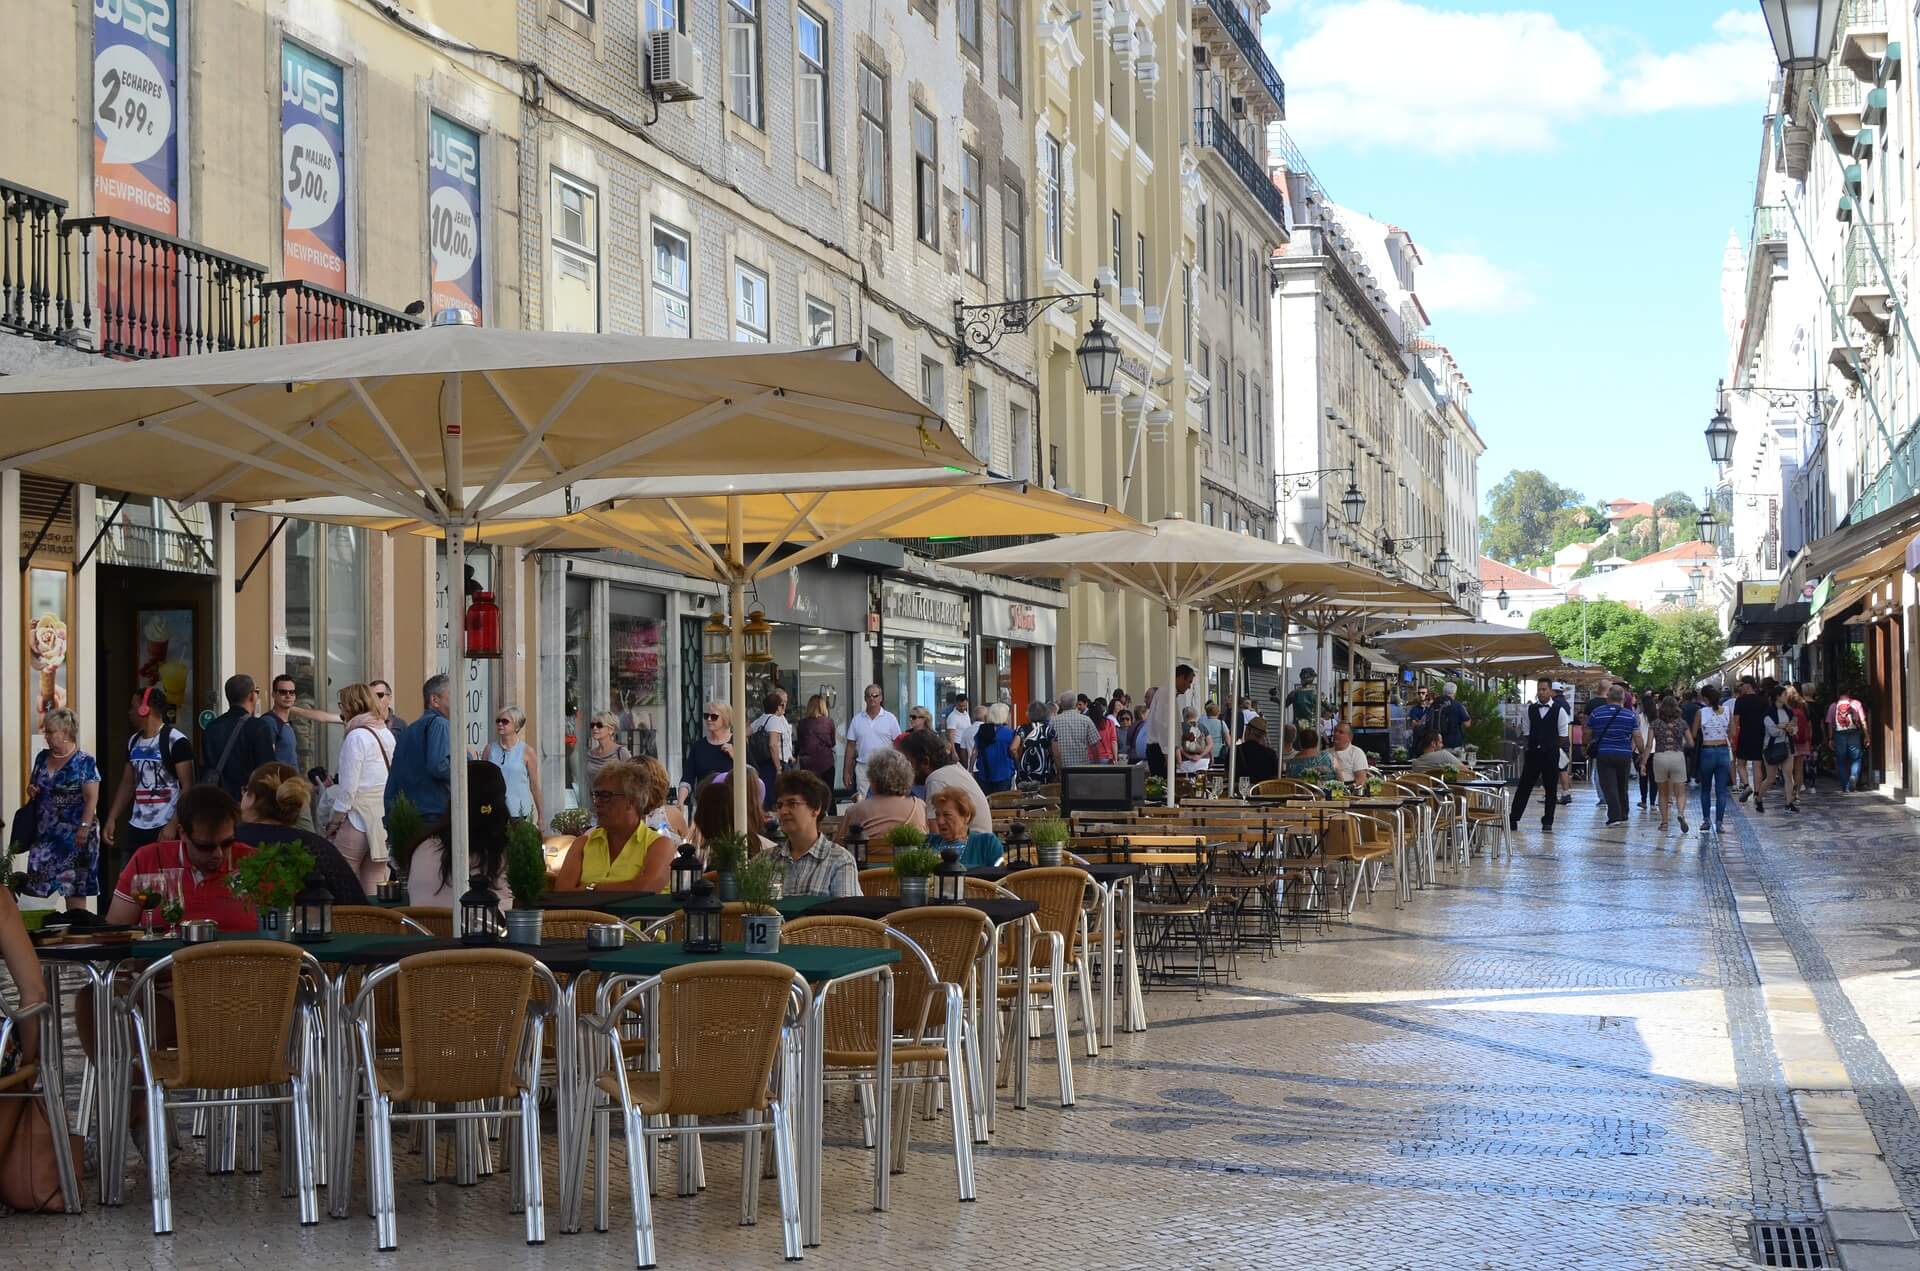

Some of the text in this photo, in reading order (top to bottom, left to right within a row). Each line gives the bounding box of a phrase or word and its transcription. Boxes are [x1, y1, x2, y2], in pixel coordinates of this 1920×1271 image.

[121, 70, 163, 100] ECHARPES
[304, 147, 332, 171] MALHAS
[935, 599, 963, 626] BARRAL
[749, 922, 767, 945] 12
